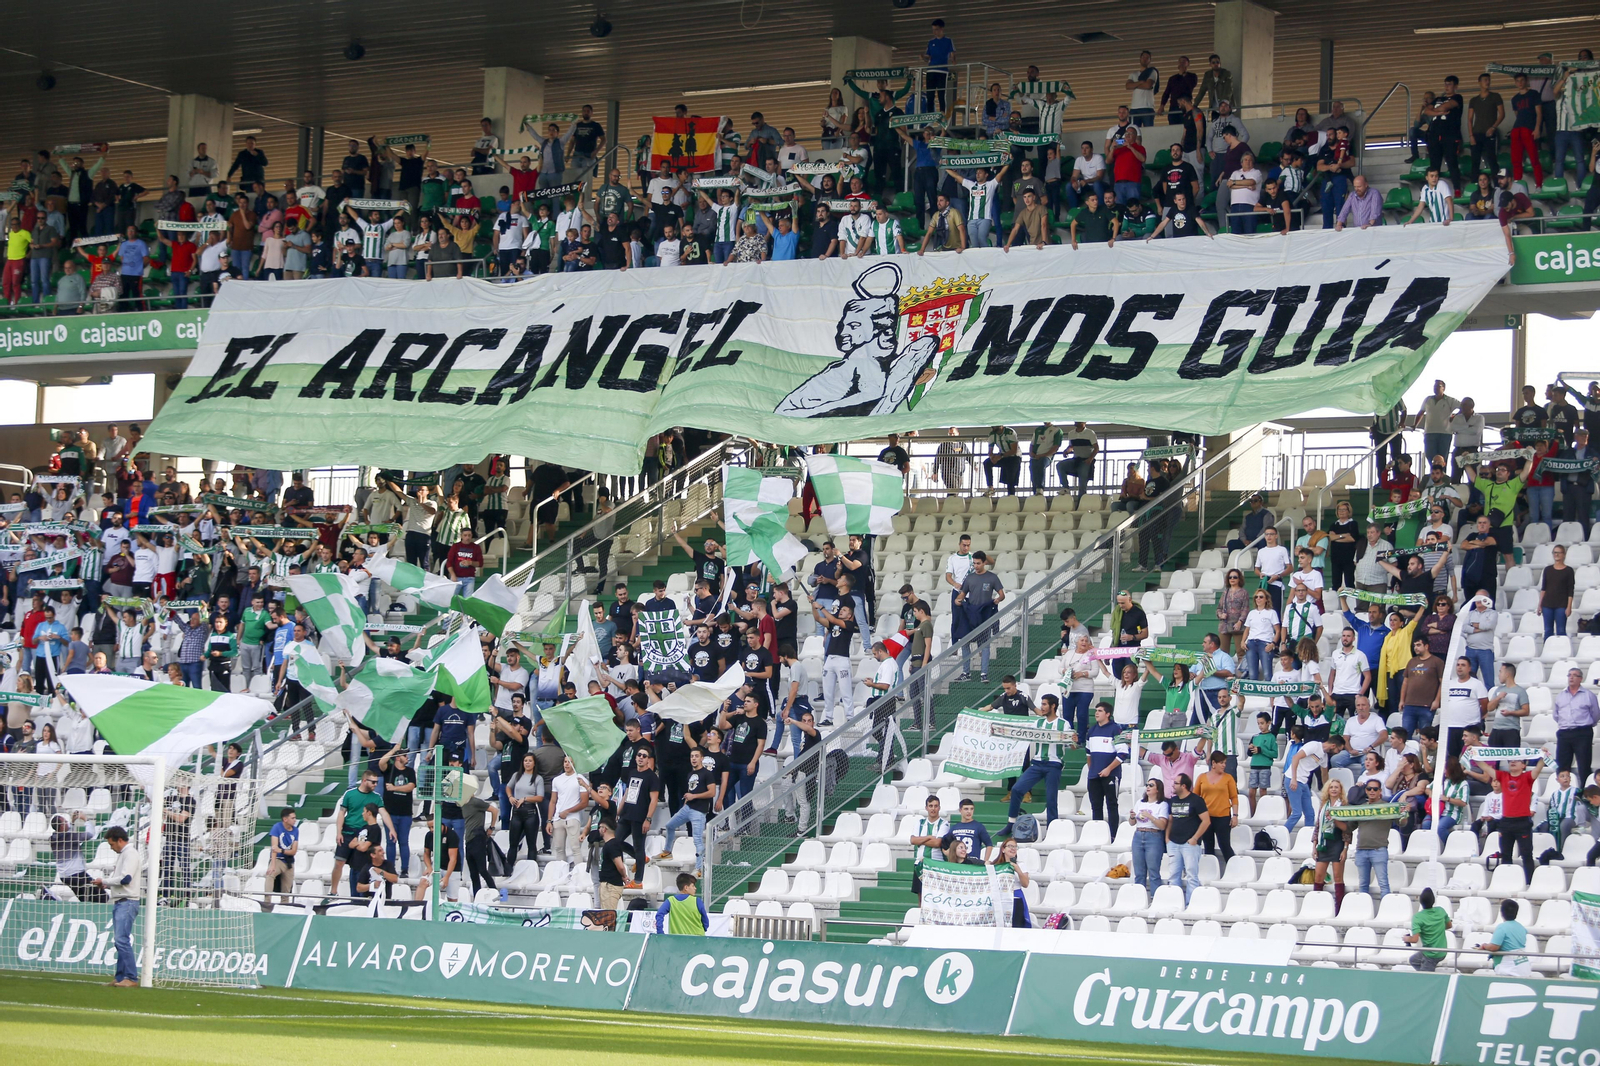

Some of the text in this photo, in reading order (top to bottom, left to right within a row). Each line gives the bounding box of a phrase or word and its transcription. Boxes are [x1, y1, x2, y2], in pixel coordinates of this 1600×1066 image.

[856, 68, 901, 79] CÓRDOBA CF
[950, 155, 986, 166] CÓRDOBA
[536, 184, 571, 197] CÓRDOBA
[1507, 314, 1517, 327] 5
[81, 321, 147, 348] cajasur
[186, 258, 1450, 406] EL ARCÁNGEL NOS GUÍA
[217, 495, 266, 509] CÓRDOBA CF
[30, 556, 57, 568] CÓRDOBA
[1096, 648, 1128, 657] CÓRDOBA
[617, 672, 625, 680] N
[1242, 683, 1298, 696] CÓRDOBA CF
[1010, 728, 1052, 741] CÓRDOBA
[923, 893, 994, 908] CÓRDOBA
[166, 945, 268, 976] CÓRDOBA
[302, 939, 631, 986] ALVARO MORENO
[680, 941, 919, 1014] cajasur
[1159, 965, 1305, 986] DESDE 1904
[1072, 967, 1379, 1051] Cruzcampo
[1479, 982, 1599, 1041] PT
